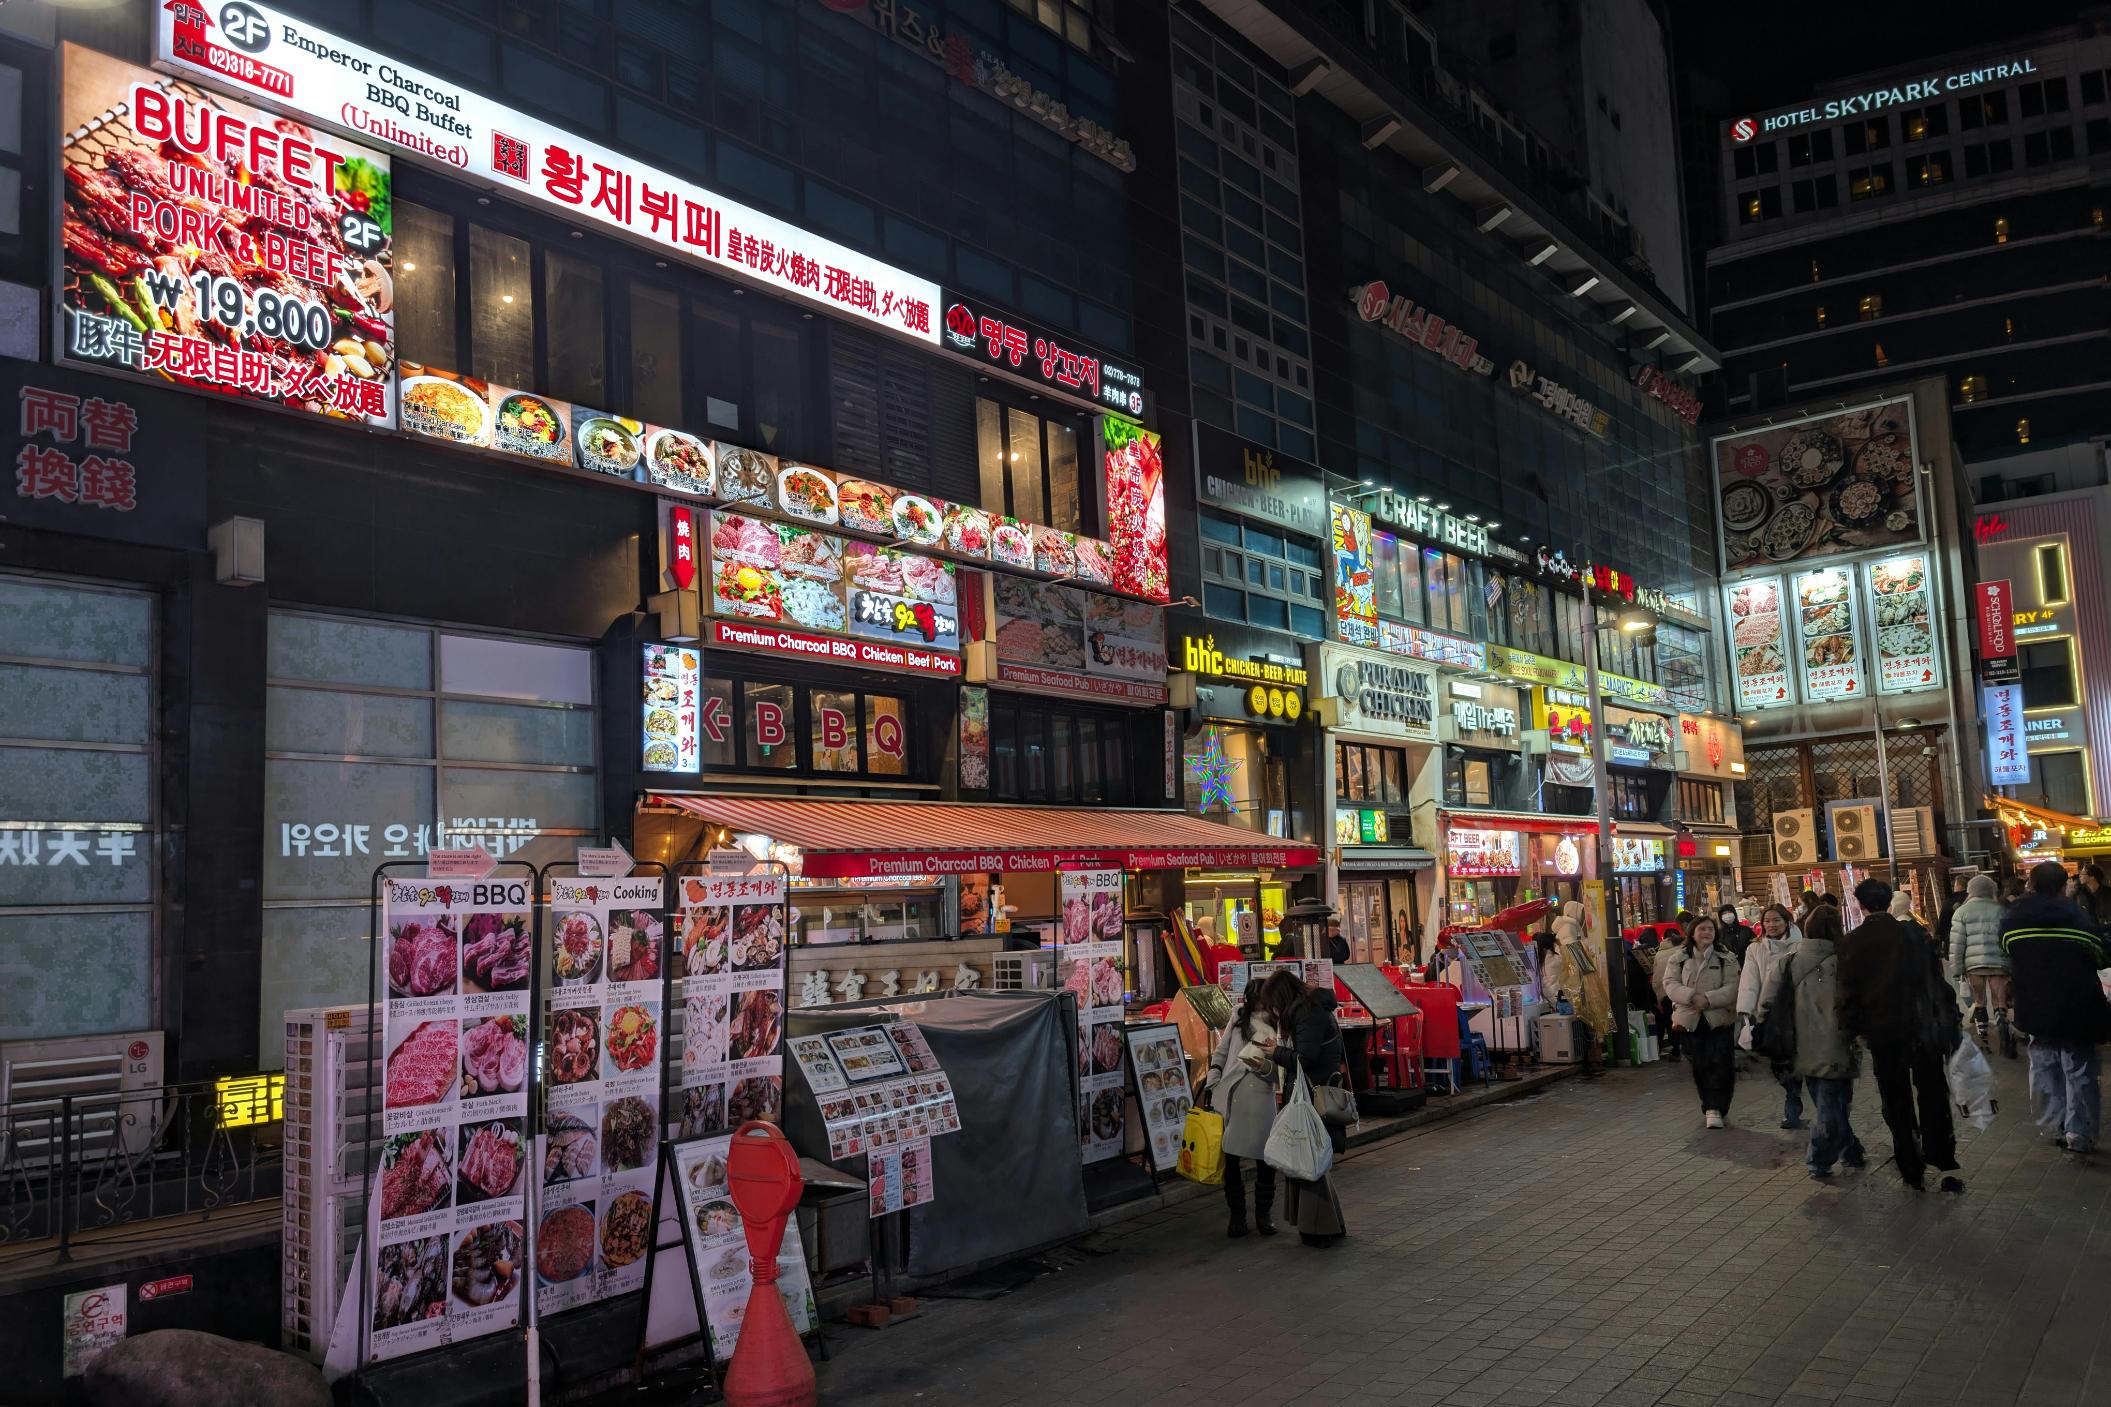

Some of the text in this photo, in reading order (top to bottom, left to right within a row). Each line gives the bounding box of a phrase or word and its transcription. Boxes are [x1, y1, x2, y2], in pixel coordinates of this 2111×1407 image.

[174, 2, 206, 29] 입구
[224, 9, 268, 44] 2F
[174, 35, 206, 59] 入口
[208, 46, 292, 94] 02)318-7771
[283, 25, 461, 112] Emperor Charcoal
[366, 83, 472, 139] BBQ Buffet
[1764, 59, 2037, 132] HOTEL SKYPARK CENTRAL
[132, 86, 346, 199] BUFFET
[341, 102, 469, 169] (Unlimited)
[168, 161, 311, 231] UNLIMITED
[541, 144, 720, 259] 황제뷔페
[131, 193, 344, 287] PORK & BEEF
[343, 218, 381, 248] 2F
[146, 271, 331, 350] ₩ 19,800
[981, 316, 1099, 397] 명동 양꼬치
[1103, 385, 1127, 407] 羊肉串
[1129, 393, 1142, 413] 3F
[19, 386, 138, 452] 両替
[17, 444, 137, 511] 換錢
[1243, 447, 1281, 493] bhc
[1260, 495, 1285, 519] BEER
[1380, 491, 1440, 539] CRAFT
[1444, 513, 1489, 556] BEER
[721, 626, 956, 673] Premium Charcoal BBQ Chicken Beef Pork
[1185, 636, 1223, 676] bhc
[1003, 668, 1040, 684] Premium
[1041, 671, 1073, 688] Seafood
[1074, 676, 1090, 691] Pub
[1094, 679, 1122, 695] いざかや
[1225, 657, 1260, 679] CHICKEN
[1263, 664, 1283, 682] BEER
[1286, 667, 1308, 686] PLATE
[1358, 660, 1431, 695] PURADAK
[681, 689, 697, 755] 조개와
[1360, 690, 1432, 722] CHICKEN
[1995, 689, 2018, 761] 명동조개와
[869, 858, 923, 875] Premium
[926, 856, 977, 873] Charcoal
[980, 855, 1004, 872] BBQ
[1009, 855, 1050, 870] Chicken
[1129, 853, 1165, 867] Premium
[1166, 853, 1199, 866] Seafood
[1200, 852, 1215, 866] Pub
[1218, 853, 1247, 865] いざかや
[1096, 873, 1120, 888] BBQ
[473, 884, 526, 906] BBQ
[613, 885, 658, 903] Cooking
[710, 880, 778, 898] 명동조개와
[464, 995, 490, 1004] 생삼겹살
[129, 1062, 147, 1074] LG
[66, 1313, 123, 1337] 금연구역
